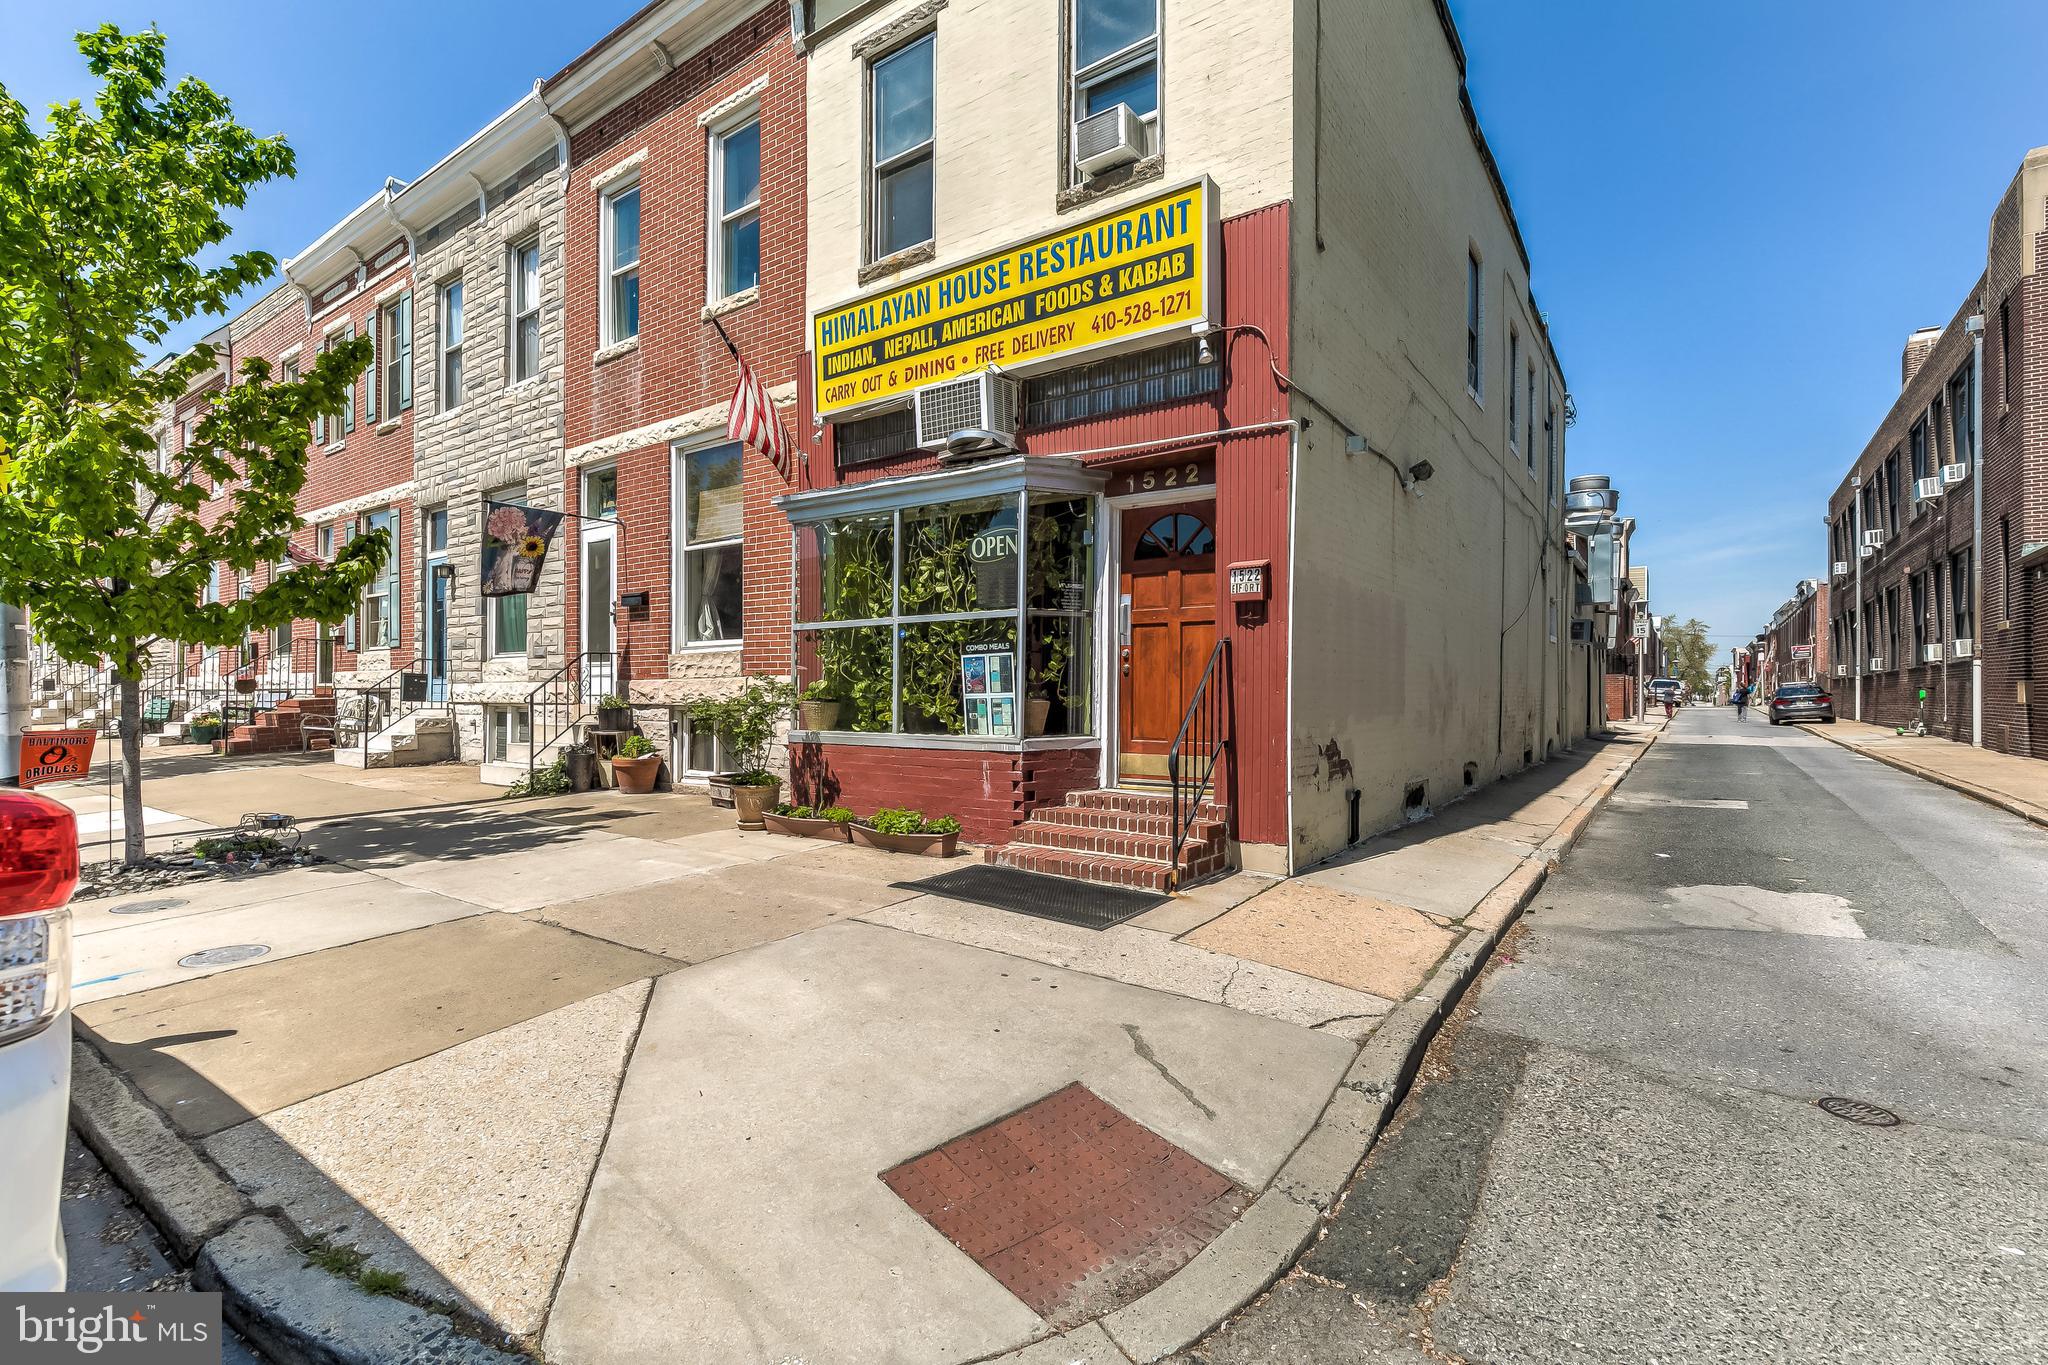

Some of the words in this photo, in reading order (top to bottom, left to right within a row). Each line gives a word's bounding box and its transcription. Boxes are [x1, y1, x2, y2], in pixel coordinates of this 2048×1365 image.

[822, 286, 931, 347] HIMALAYAN
[938, 258, 1011, 310] HOUSE
[1020, 198, 1191, 284] RESTAURANT
[828, 345, 877, 376] INDIAN,
[884, 327, 937, 359] NEPALI,
[942, 300, 1025, 343] AMERICAN
[1036, 280, 1094, 316] FOODS
[1099, 274, 1113, 297] &
[1119, 252, 1186, 293] KABAB
[825, 381, 857, 403] CARRY
[862, 373, 882, 394] OUT
[888, 370, 898, 387] &
[904, 354, 955, 383] DINING
[975, 340, 1005, 364] FREE
[1012, 322, 1076, 355] DELIVERY
[1091, 289, 1191, 334] 410-528-1271
[1126, 463, 1199, 493] 1522
[971, 534, 1018, 558] OPEN
[1231, 568, 1261, 582] 1522
[966, 644, 988, 652] COMBO
[989, 642, 1010, 650] MEALS
[29, 736, 89, 747] BALTIMORE
[25, 764, 79, 780] ORIOLES
